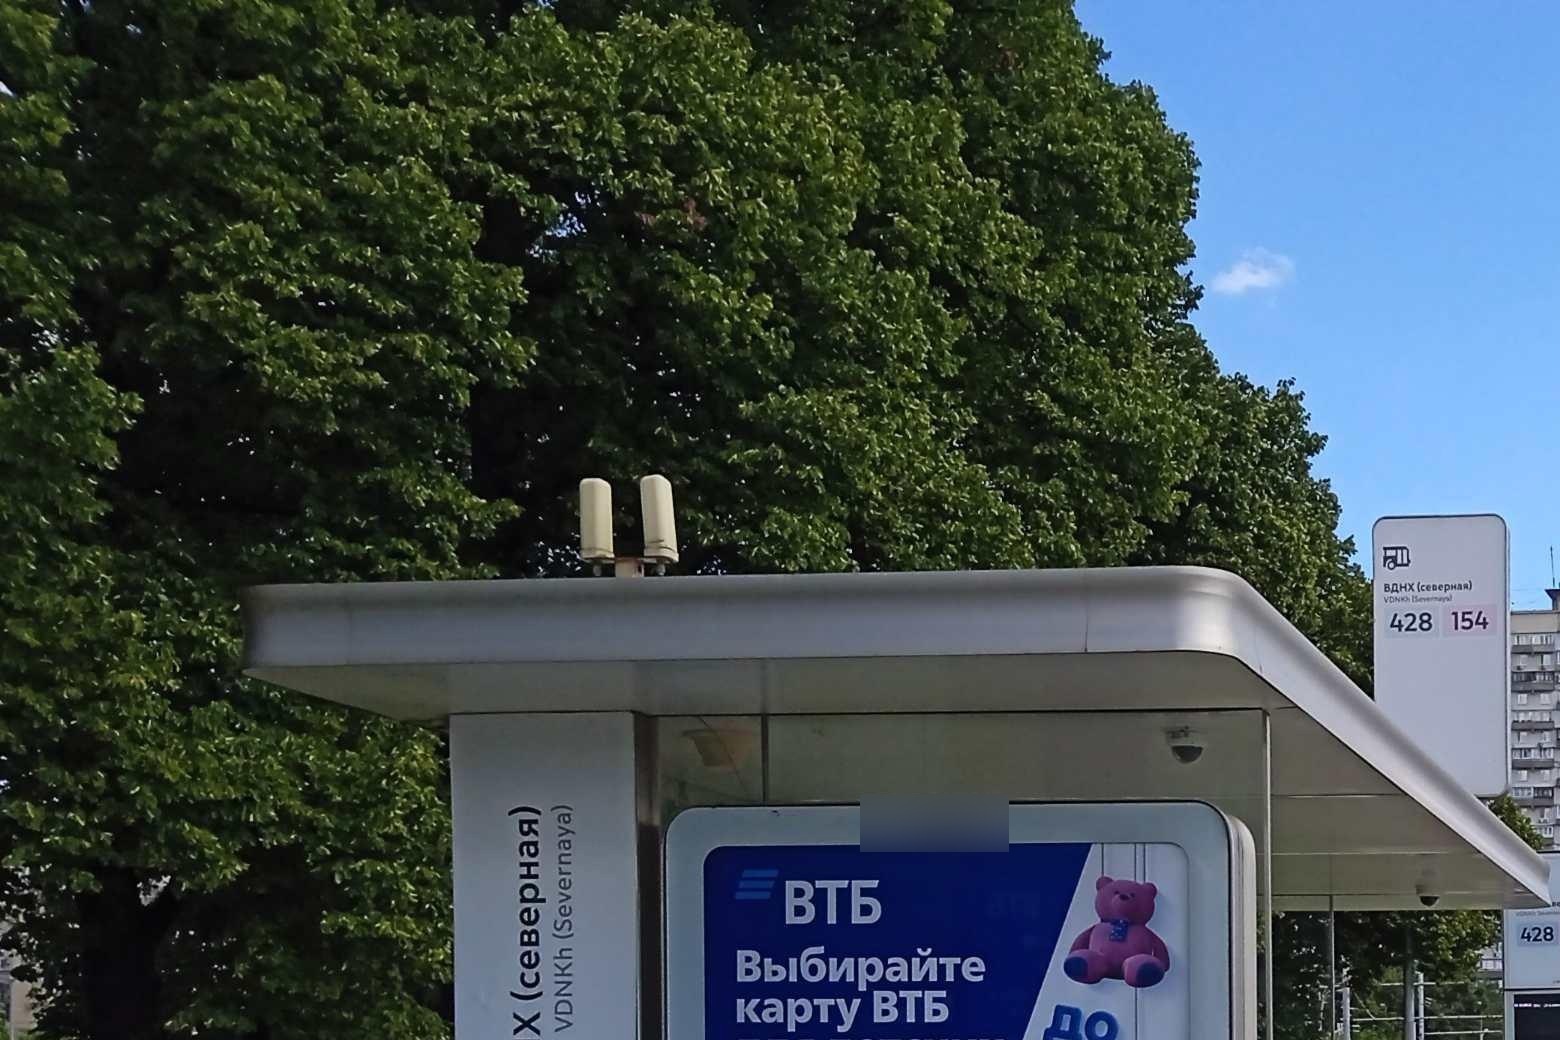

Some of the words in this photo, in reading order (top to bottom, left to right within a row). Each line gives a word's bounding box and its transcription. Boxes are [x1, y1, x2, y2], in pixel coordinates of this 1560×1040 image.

[1384, 583, 1415, 593] ВДНХ
[1417, 580, 1473, 593] (северная)
[1389, 612, 1433, 632] 428
[1451, 610, 1489, 631] 154
[550, 803, 576, 940] (Severnaya)
[508, 805, 547, 1002] (северная)
[785, 879, 883, 925] ВТБ
[1521, 926, 1554, 942] 428
[553, 946, 575, 1034] VDNKh
[736, 946, 986, 991] Выбирайте
[736, 997, 862, 1033] карту
[872, 990, 950, 1024] ВТБ
